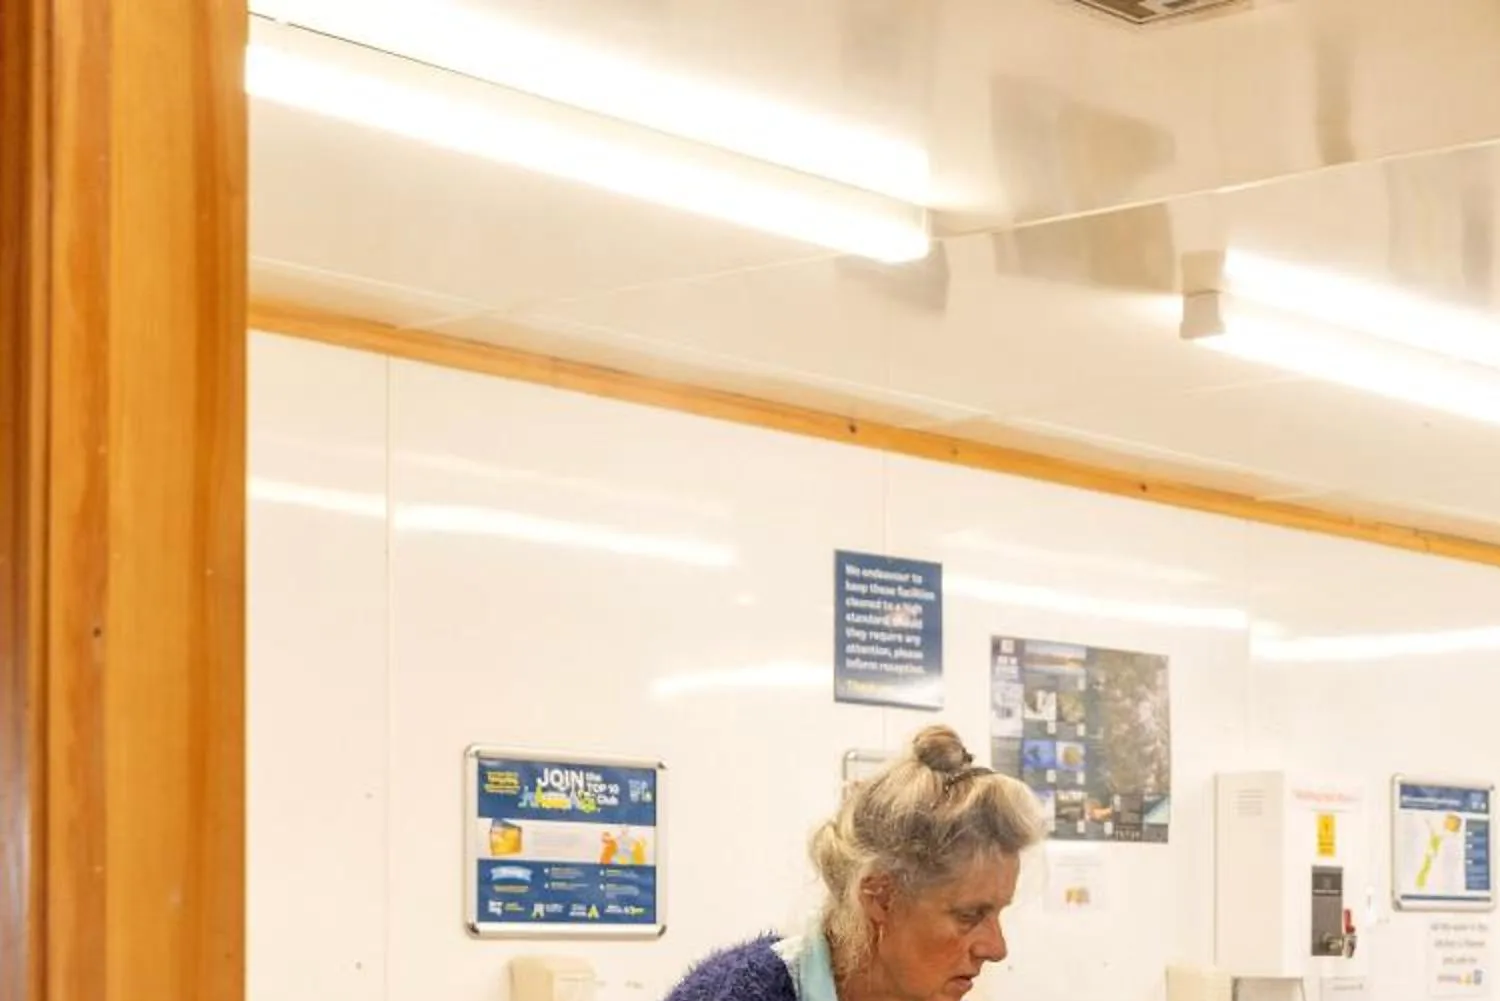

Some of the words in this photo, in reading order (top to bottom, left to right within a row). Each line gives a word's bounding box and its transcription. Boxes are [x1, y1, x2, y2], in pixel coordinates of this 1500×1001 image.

[845, 579, 868, 596] keep
[845, 627, 867, 642] they
[536, 767, 585, 790] JOIN
